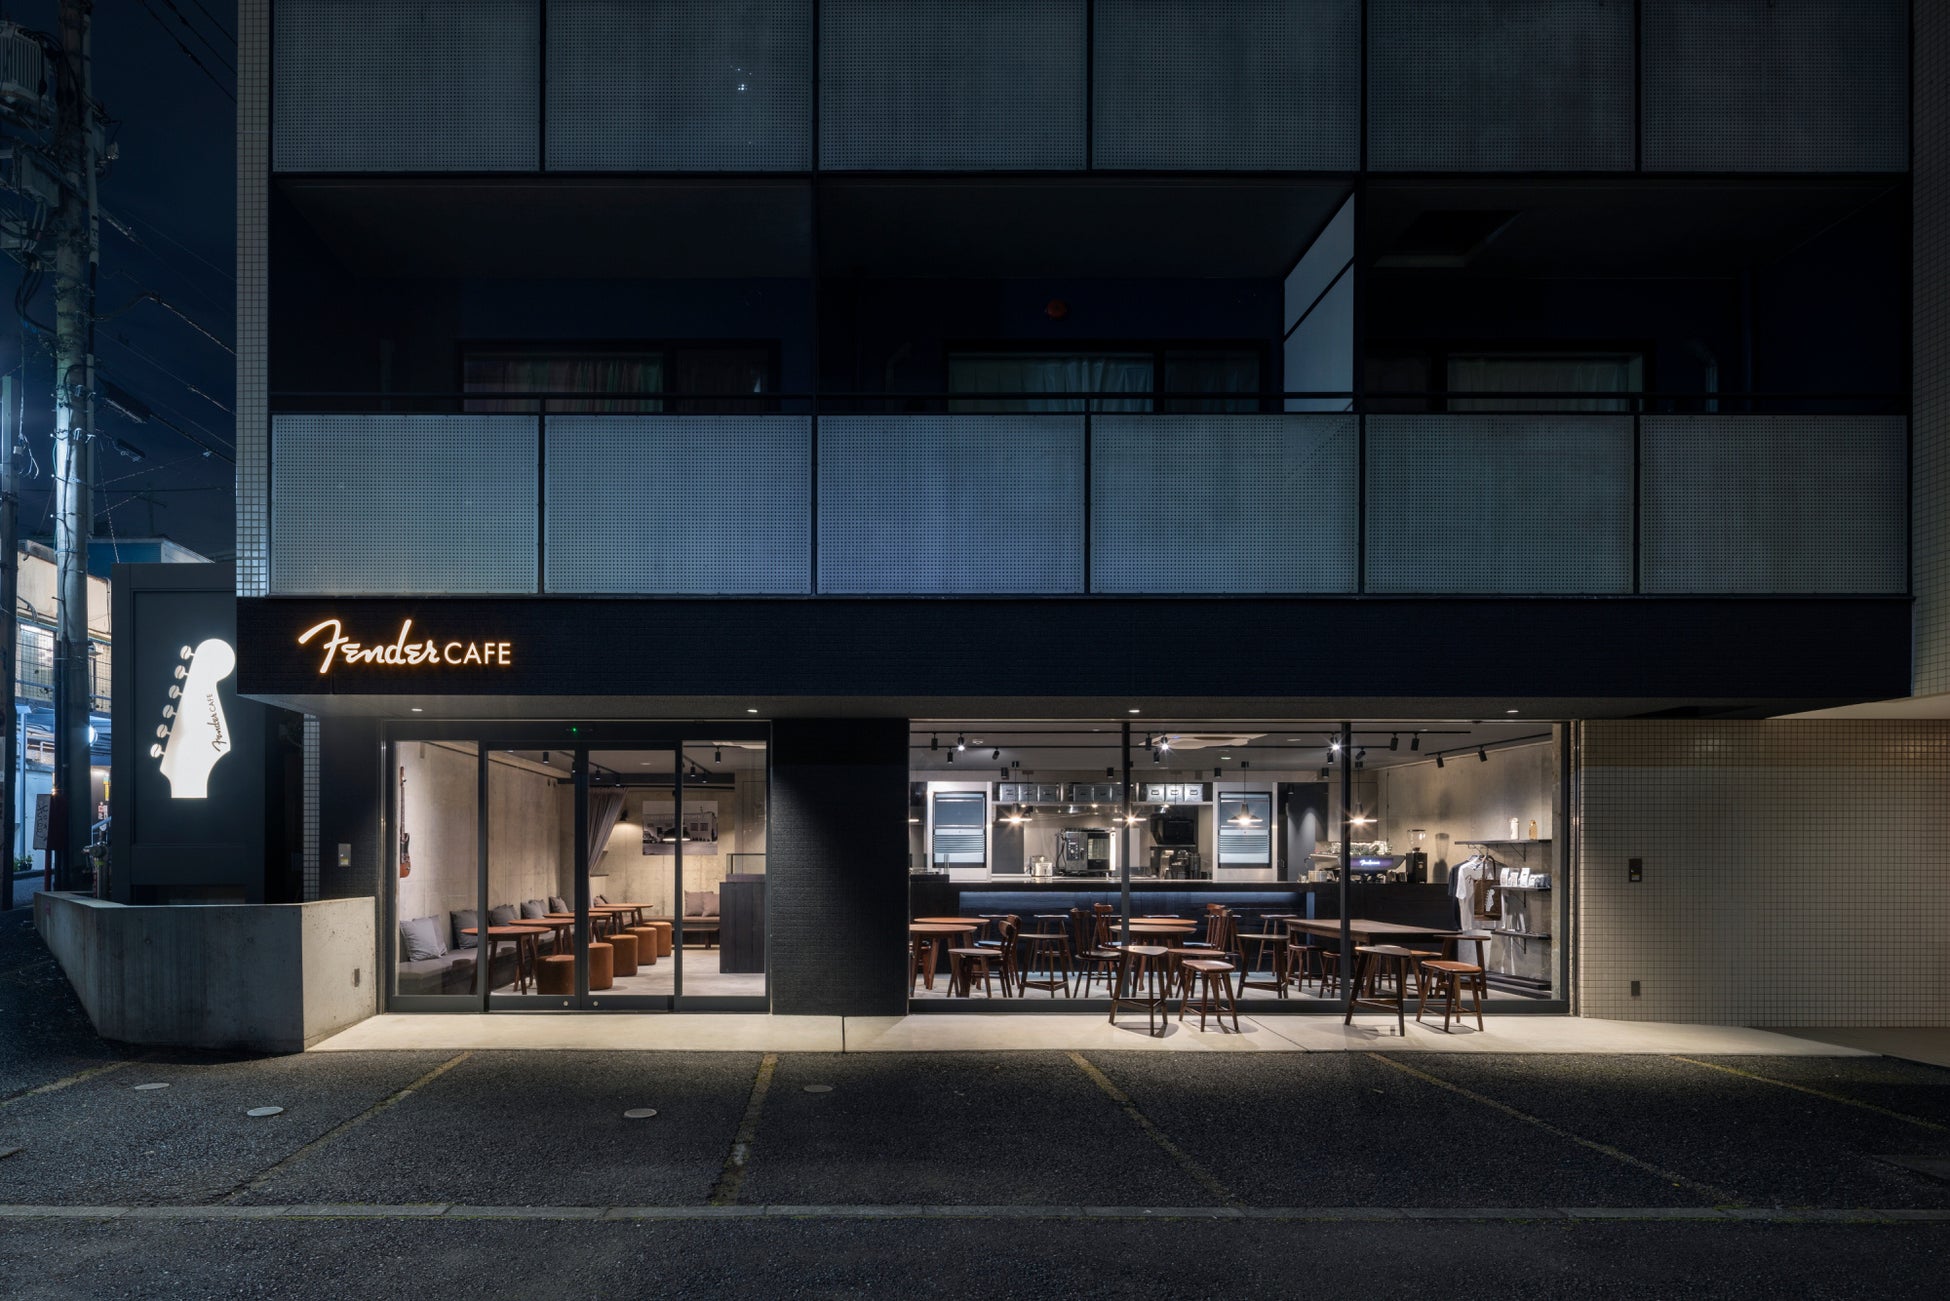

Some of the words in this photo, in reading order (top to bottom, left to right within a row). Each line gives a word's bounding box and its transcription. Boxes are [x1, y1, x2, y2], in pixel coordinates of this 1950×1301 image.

[298, 619, 440, 674] Fender
[444, 642, 511, 665] CAFE
[207, 713, 227, 752] Fender
